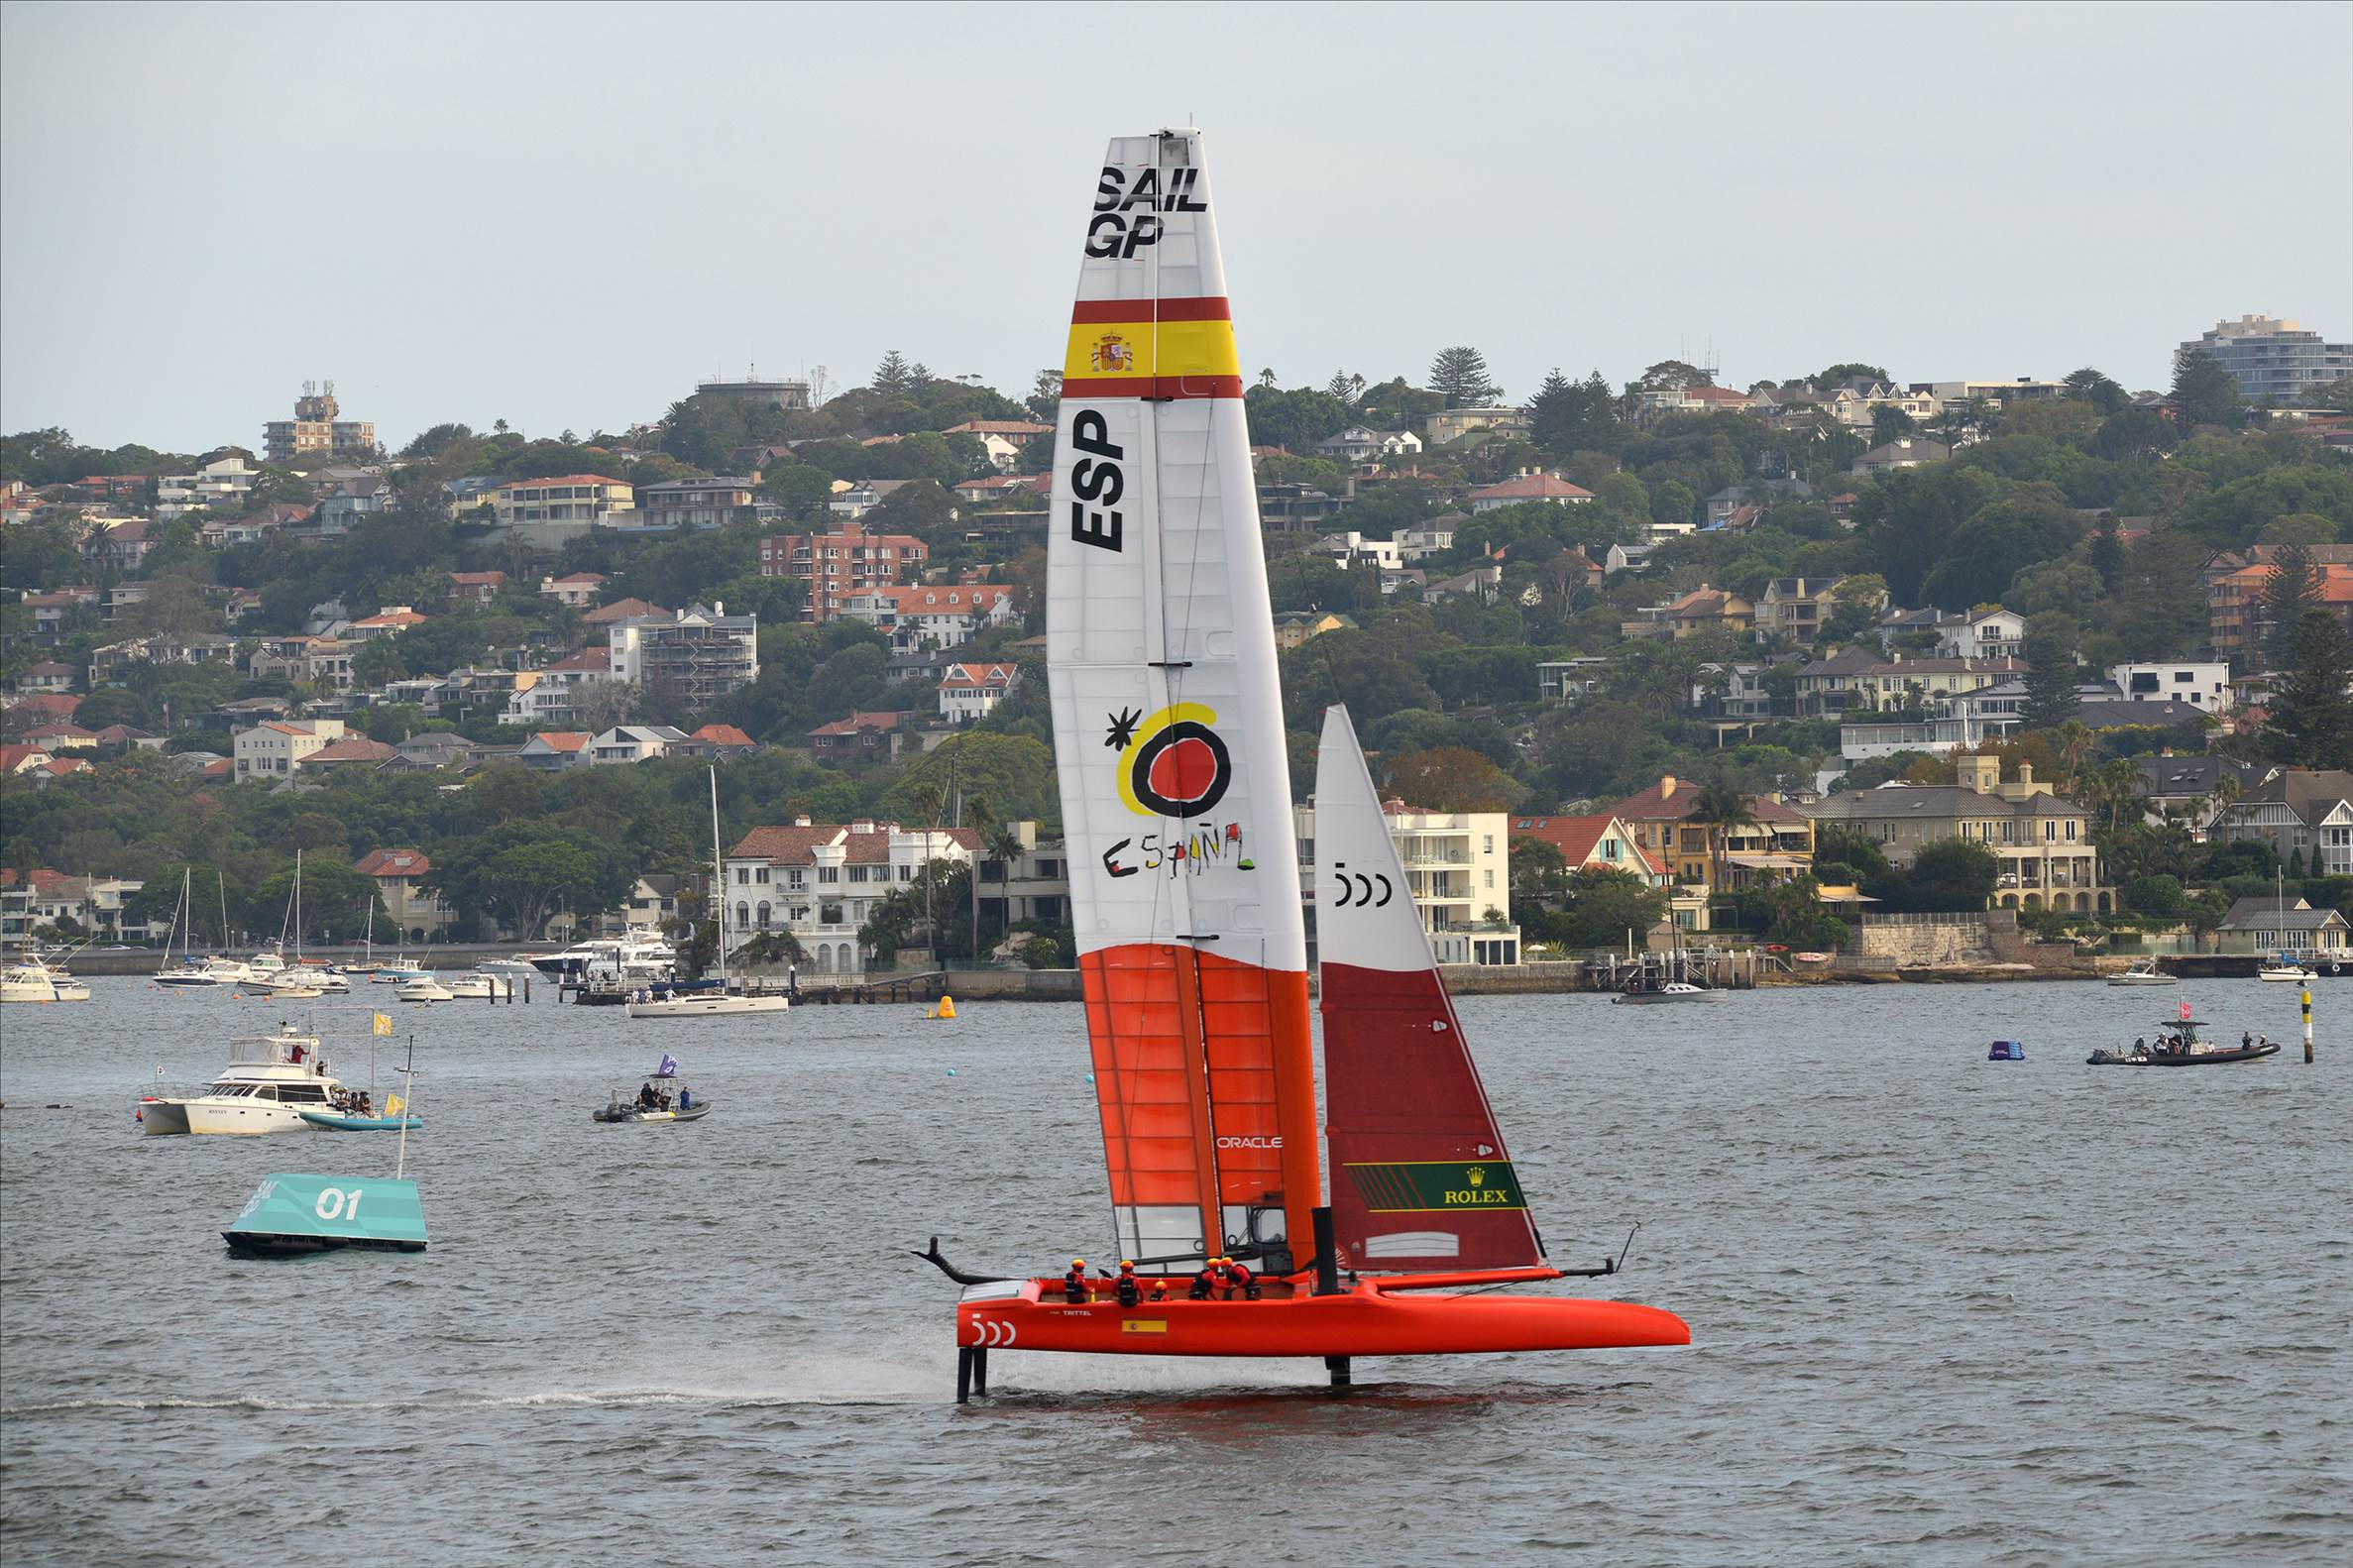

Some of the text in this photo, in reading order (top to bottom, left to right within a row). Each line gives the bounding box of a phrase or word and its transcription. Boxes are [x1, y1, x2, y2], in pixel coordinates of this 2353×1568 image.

[1093, 167, 1208, 212] SAIL
[1084, 214, 1166, 259] GP
[1071, 408, 1125, 553] ESP
[1216, 1136, 1284, 1149] ORACLE
[315, 1187, 363, 1221] 01
[1444, 1189, 1509, 1204] ROLEX
